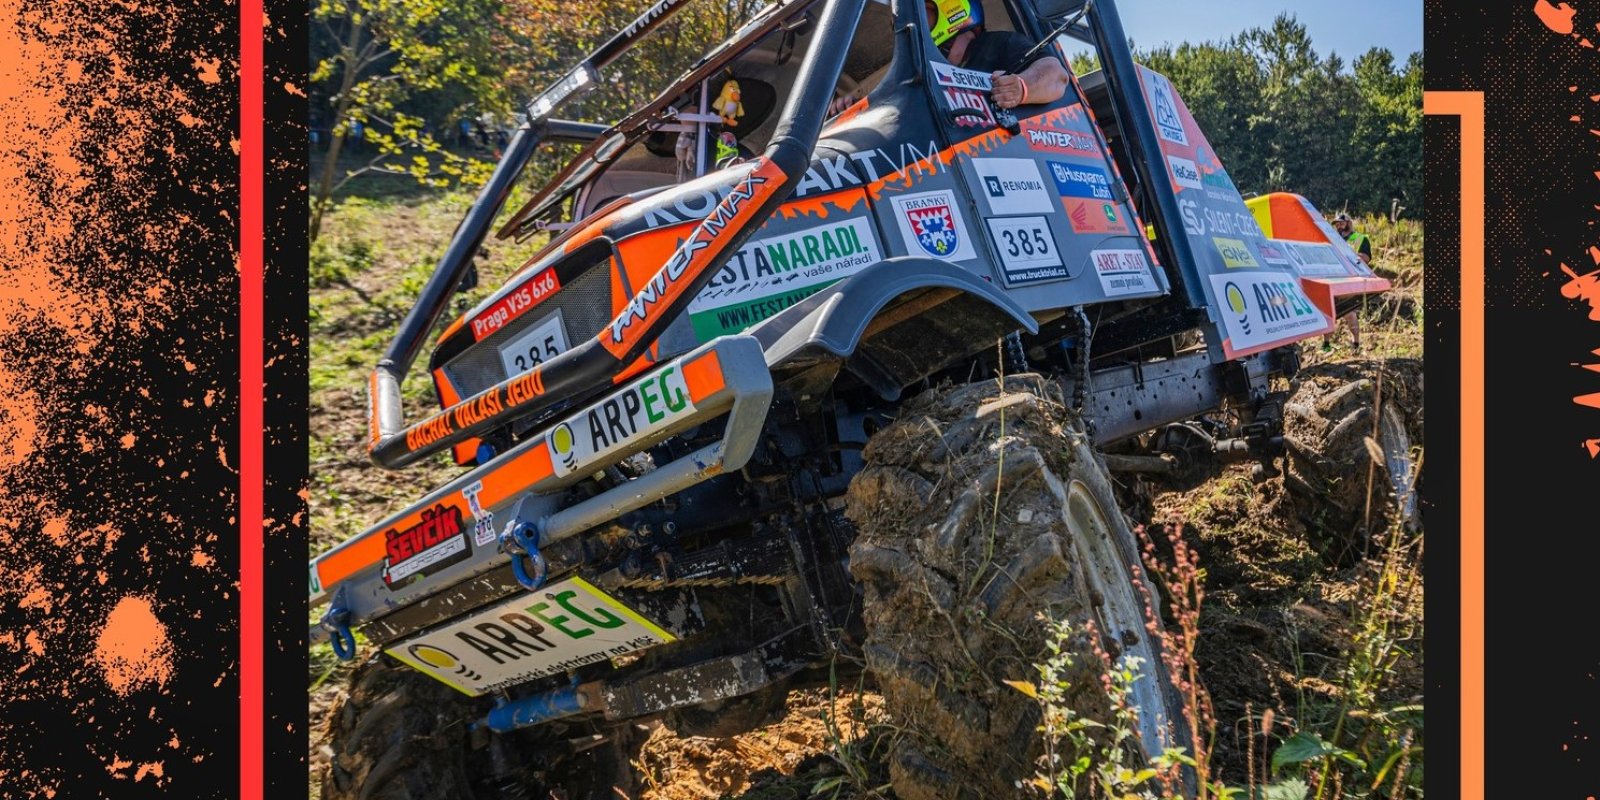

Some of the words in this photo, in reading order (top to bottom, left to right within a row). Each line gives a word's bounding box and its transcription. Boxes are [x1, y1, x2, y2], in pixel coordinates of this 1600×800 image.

[951, 67, 990, 89] ŠEVČÍK
[1003, 180, 1043, 191] RENOMIA
[1064, 166, 1107, 186] Husqvarna
[703, 172, 769, 237] MAX
[905, 196, 947, 210] BRANKY
[1002, 228, 1049, 257] 385
[803, 264, 833, 278] vaše
[1008, 267, 1067, 281] www.trucktrial.cz
[473, 307, 509, 336] Praga
[507, 288, 532, 313] V3S
[532, 272, 555, 299] 6x6
[1252, 282, 1313, 323] ARPEG
[515, 335, 559, 371] 385
[588, 367, 687, 453] ARPEG
[407, 412, 454, 451] BACHA!
[386, 504, 461, 566] ŠEVČÍK
[454, 590, 627, 664] ARPEG
[608, 645, 630, 655] na
